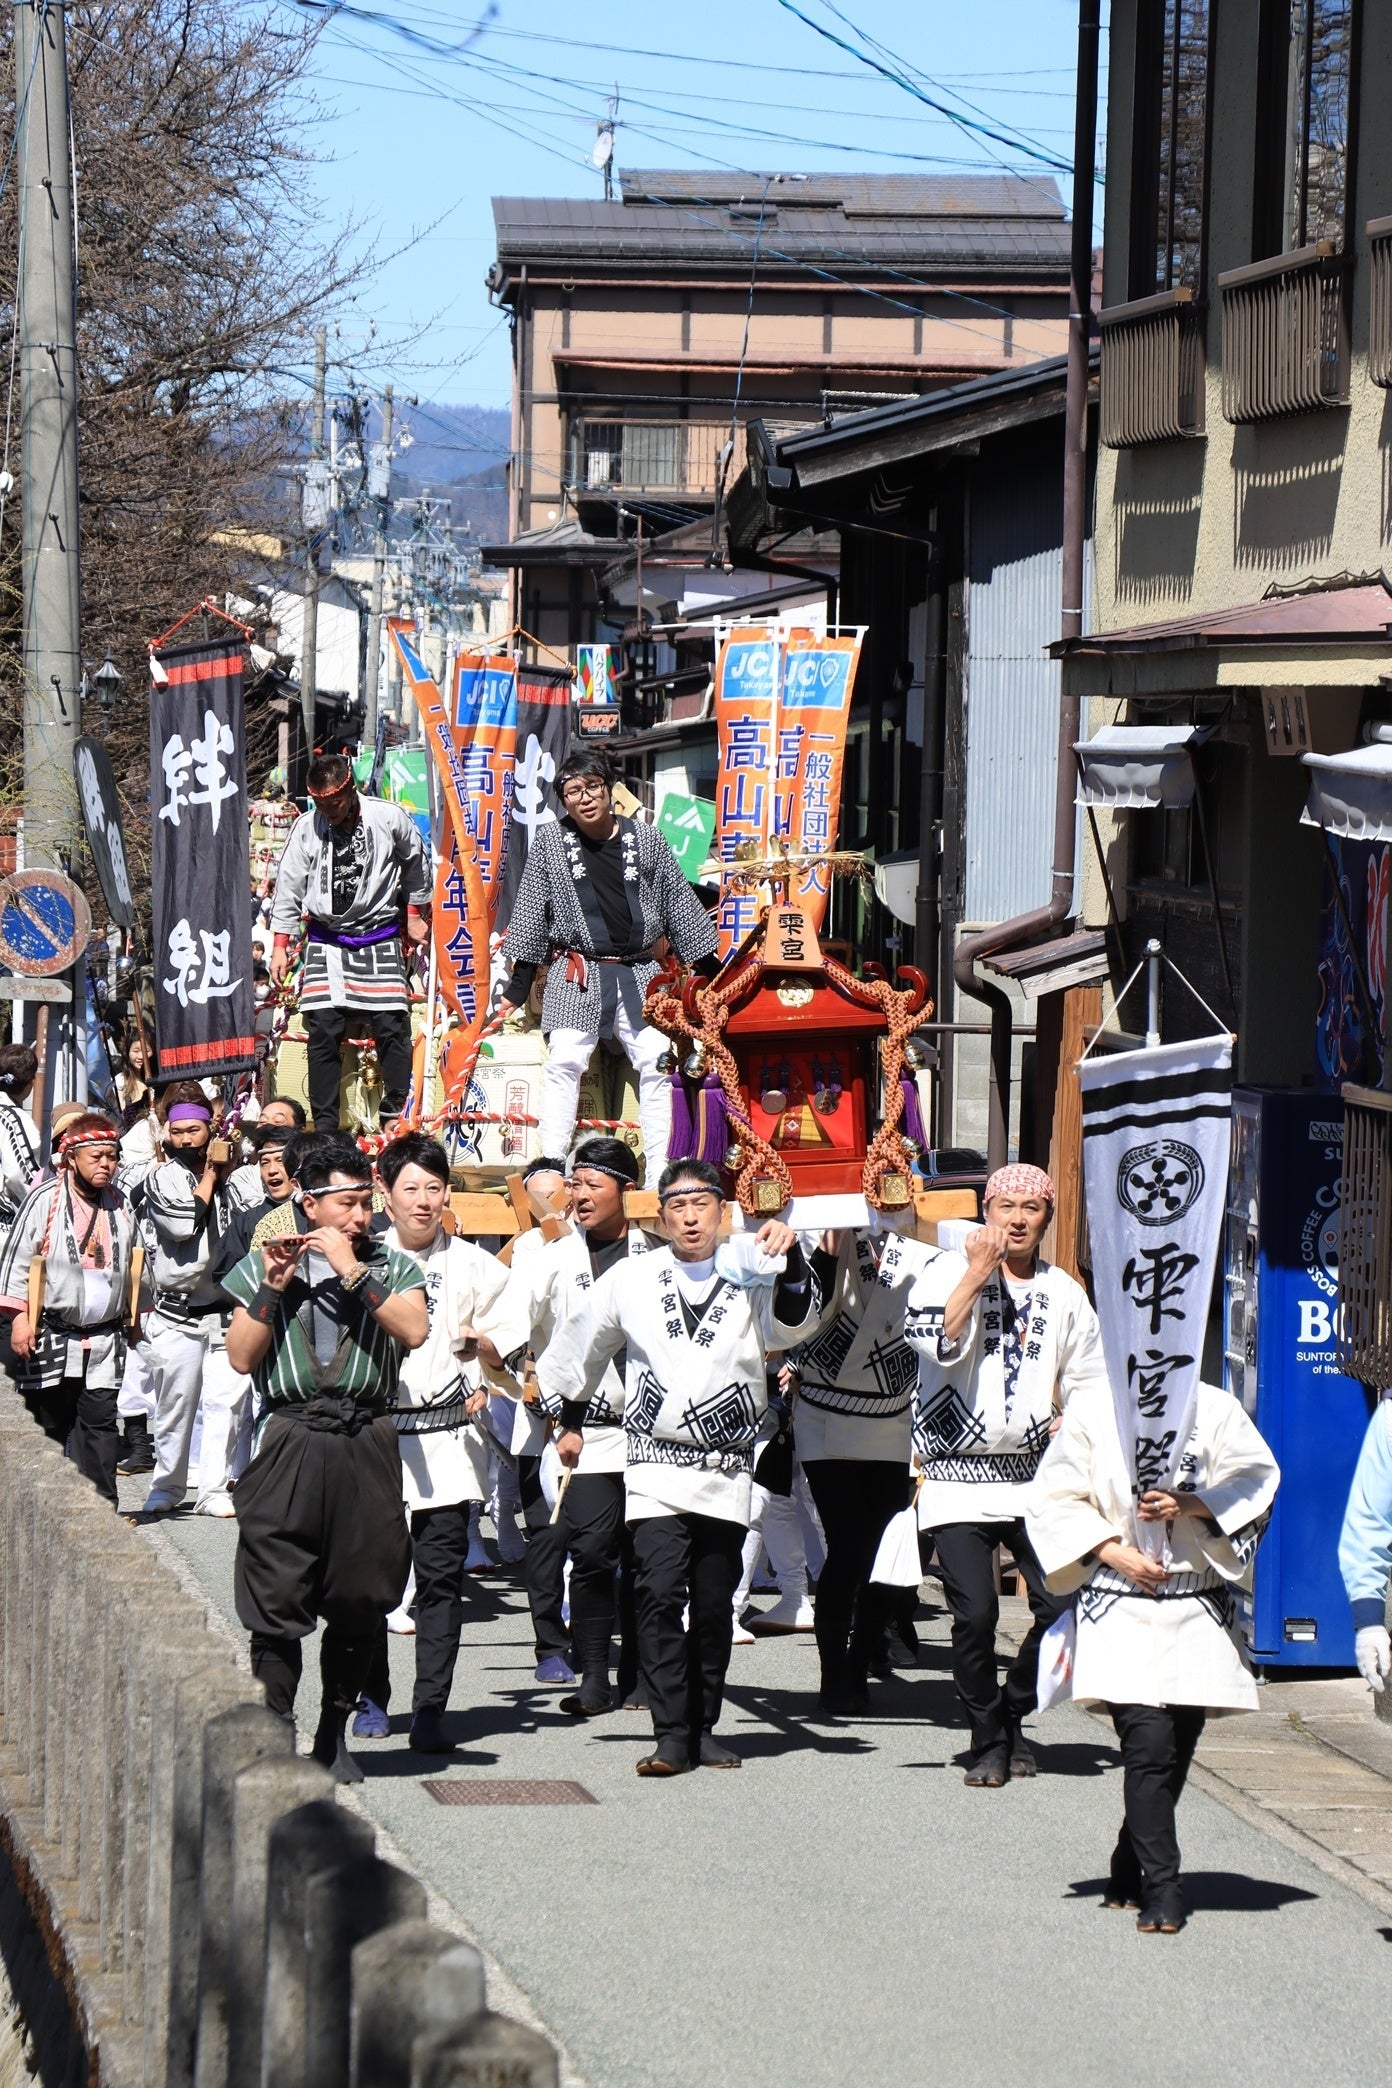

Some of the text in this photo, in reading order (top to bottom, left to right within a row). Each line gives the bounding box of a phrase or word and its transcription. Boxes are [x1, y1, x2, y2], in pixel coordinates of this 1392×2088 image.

[581, 714, 618, 729] UCC
[1301, 1209, 1324, 1263] COFFEE
[1306, 1264, 1339, 1298] BOSS
[657, 1268, 685, 1340] 雫宮祭
[981, 1284, 1002, 1357] 雫宮祭
[1312, 1365, 1322, 1374] of
